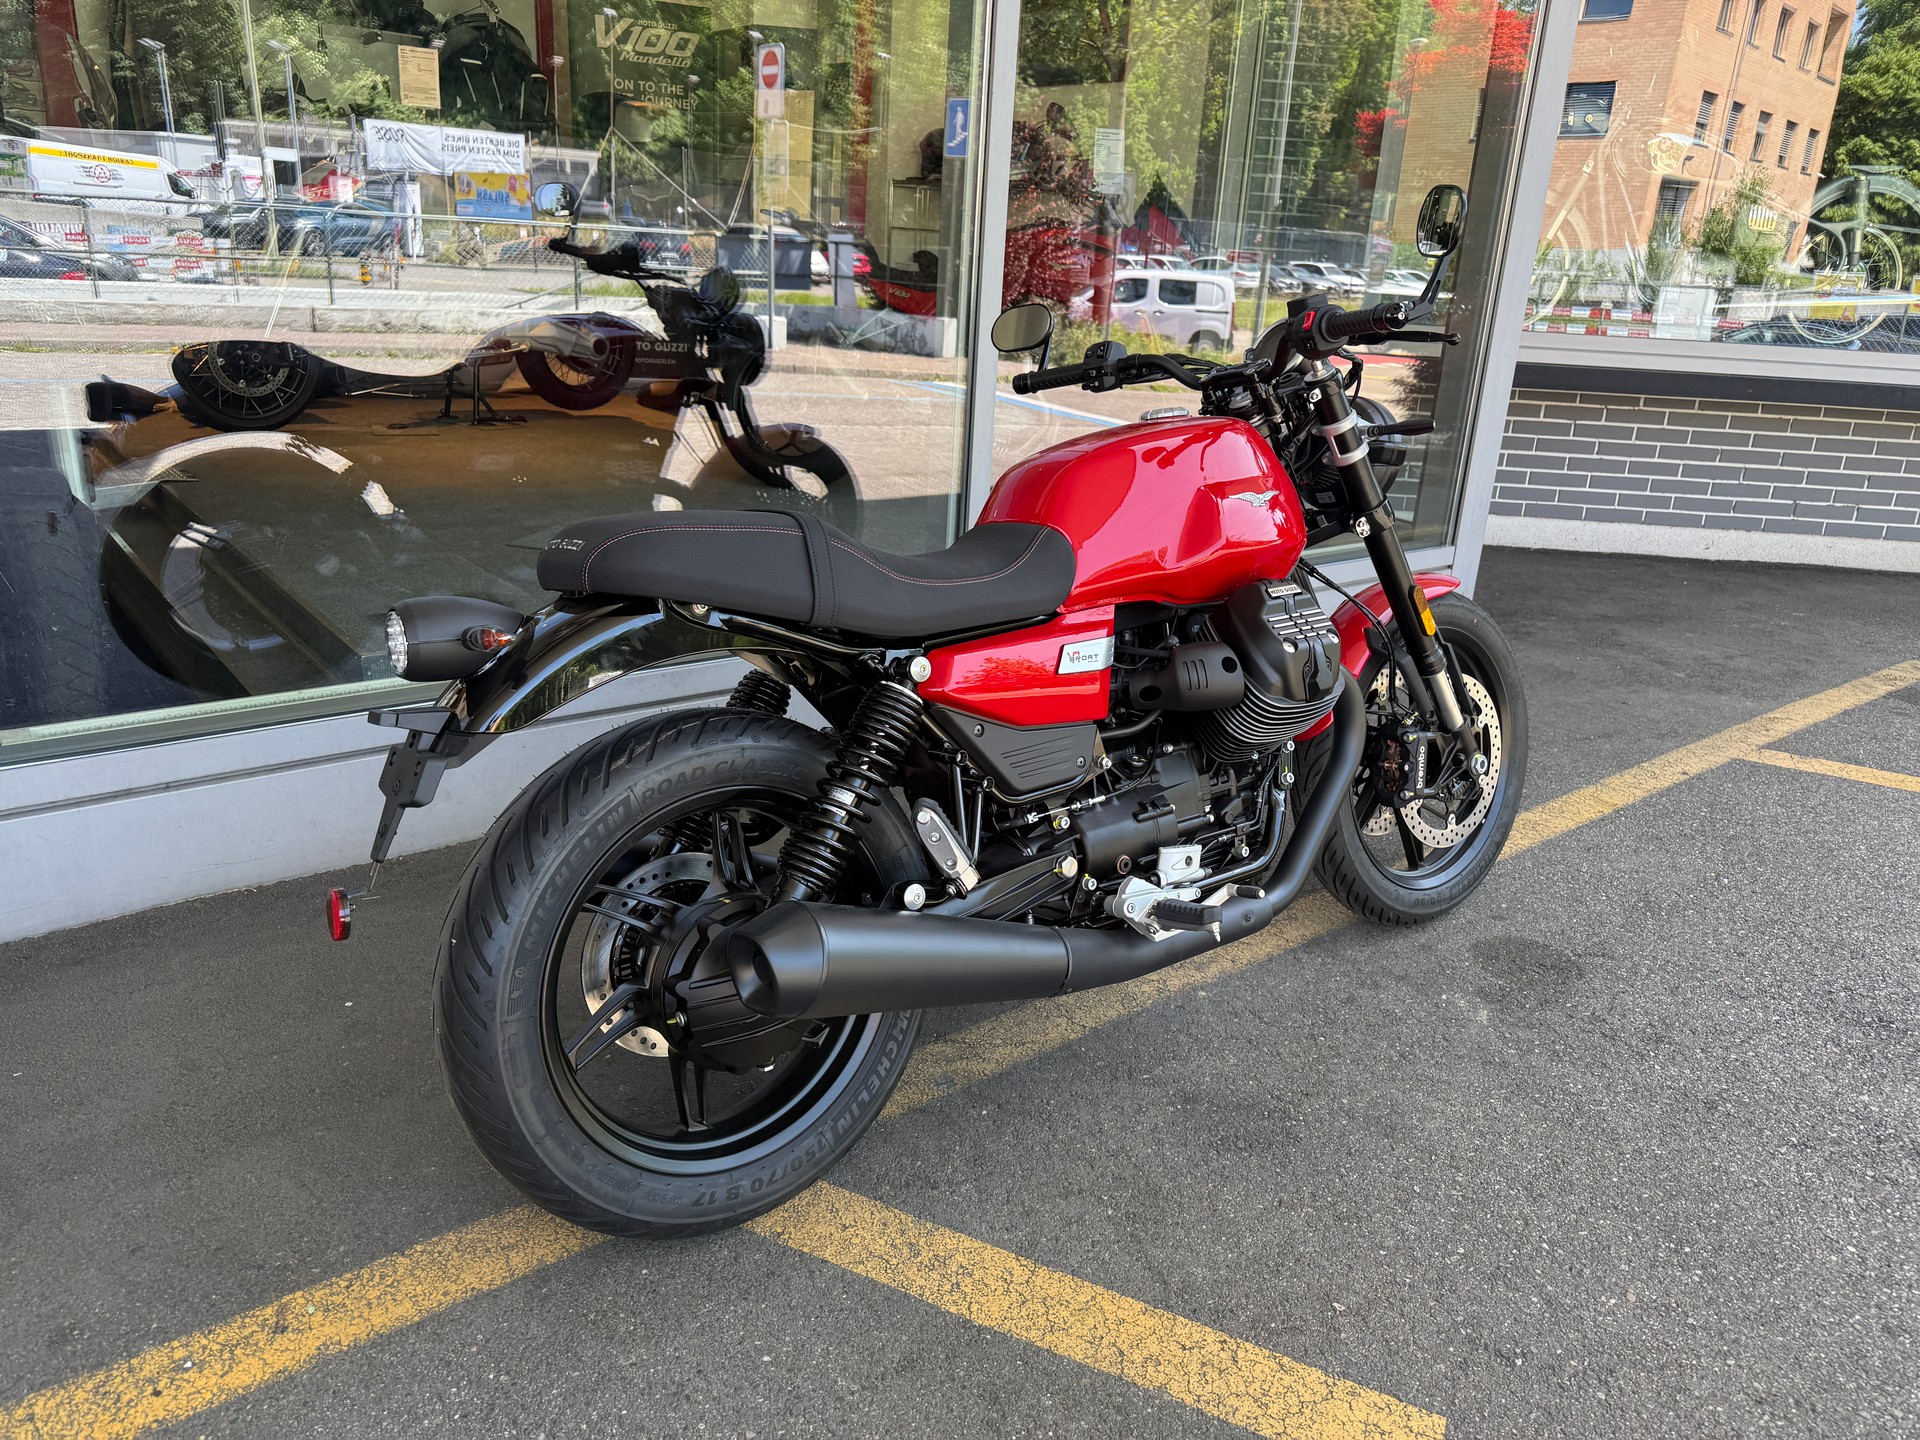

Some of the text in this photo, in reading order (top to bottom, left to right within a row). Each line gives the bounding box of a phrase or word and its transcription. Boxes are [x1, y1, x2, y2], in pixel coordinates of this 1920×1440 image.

[594, 14, 700, 58] V100
[619, 51, 692, 68] Mandello
[614, 78, 684, 96] ON TO THE
[654, 342, 688, 352] GUZZI
[1416, 745, 1426, 789] brembo
[524, 759, 808, 951] MICHELIN ROAD CLASSIC
[750, 1137, 827, 1193] 150/70
[690, 1190, 718, 1207] 17
